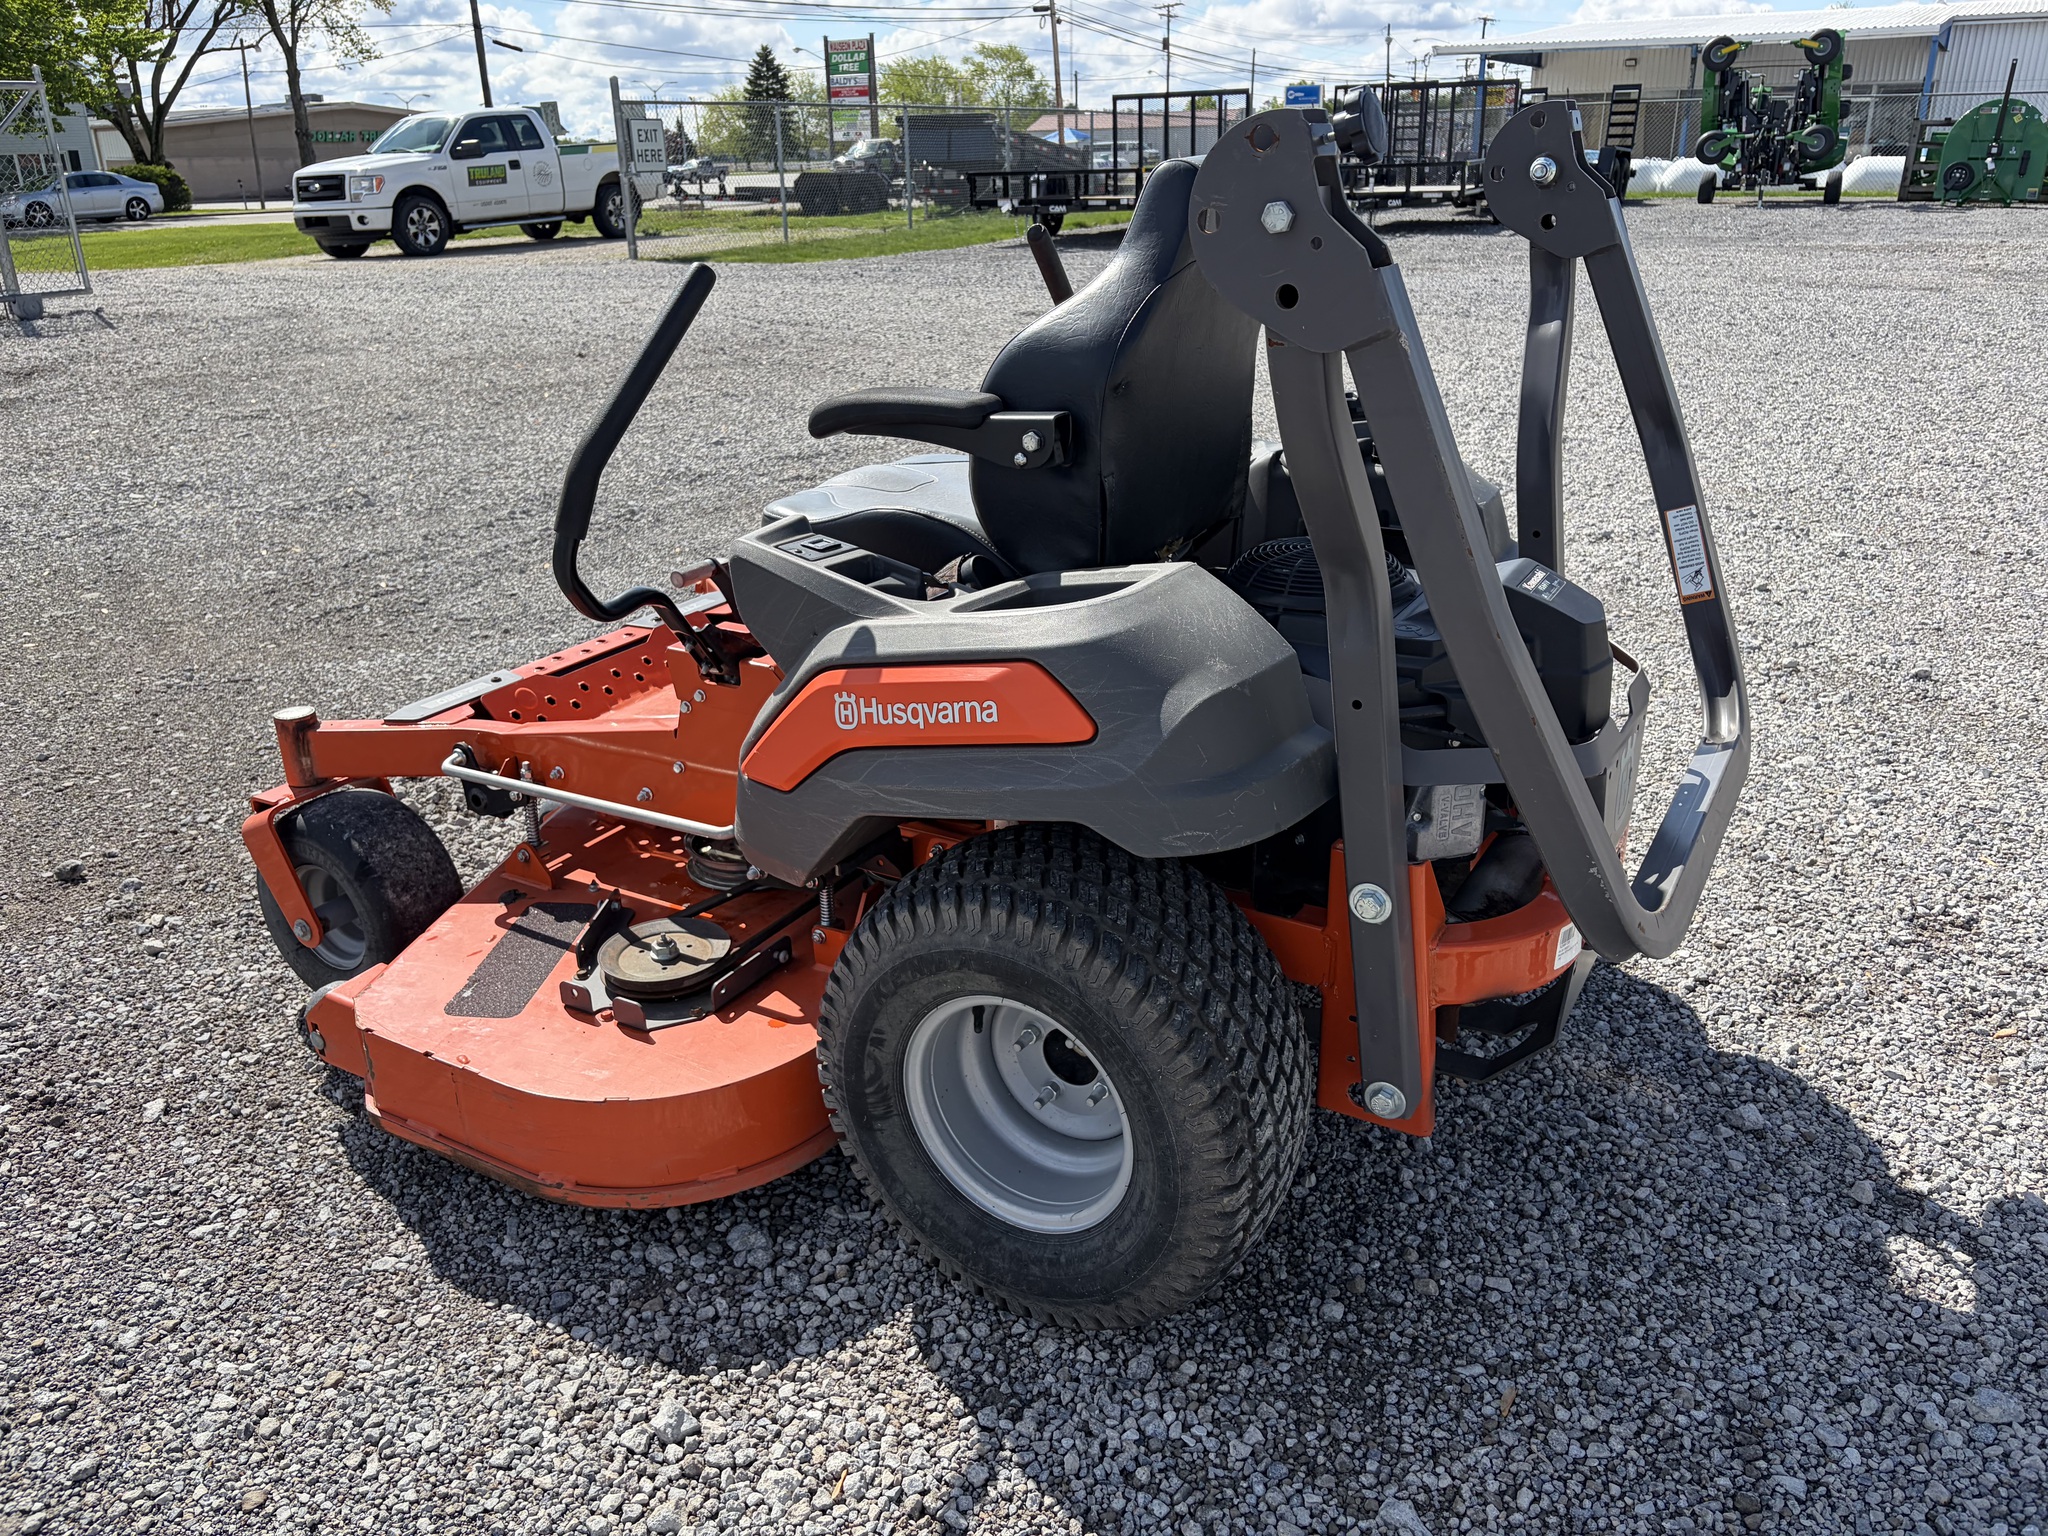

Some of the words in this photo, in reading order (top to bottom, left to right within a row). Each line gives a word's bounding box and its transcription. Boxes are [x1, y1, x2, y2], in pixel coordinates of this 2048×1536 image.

[832, 53, 865, 63] DOLLAR
[838, 62, 859, 72] TREE
[637, 129, 658, 142] EXIT
[637, 149, 663, 163] HERE
[859, 697, 999, 730] Husqvarna
[1438, 796, 1450, 839] V-VALVE
[1451, 785, 1474, 837] OHV
